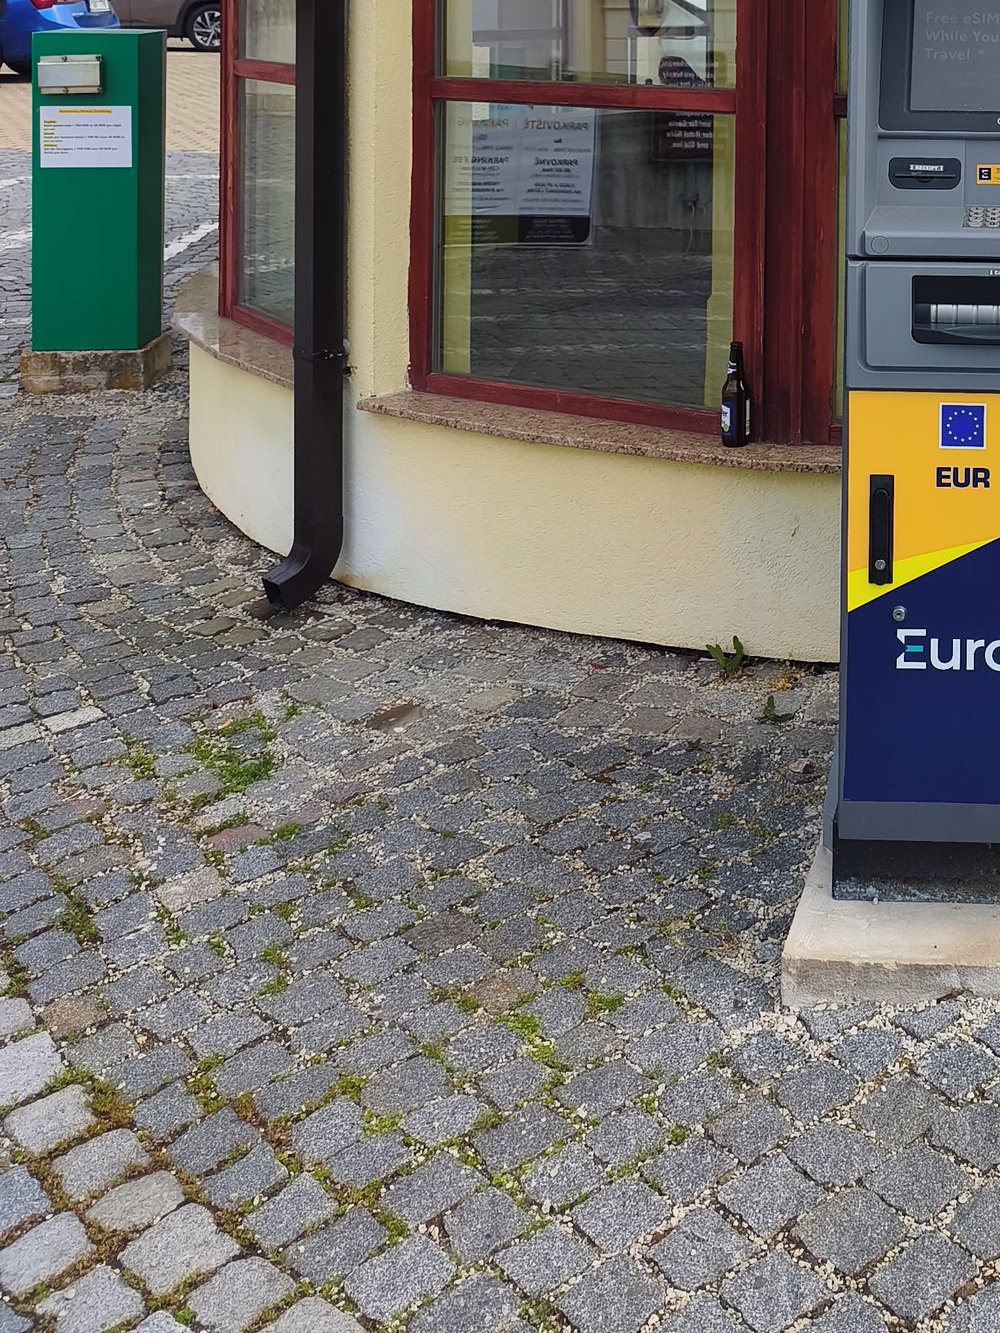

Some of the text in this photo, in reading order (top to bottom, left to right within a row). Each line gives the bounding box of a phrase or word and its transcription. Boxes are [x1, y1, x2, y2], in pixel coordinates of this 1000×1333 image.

[926, 12, 1000, 25] Free eSIM
[925, 30, 1000, 43] While You
[924, 48, 970, 60] Travel
[936, 467, 990, 488] EUR
